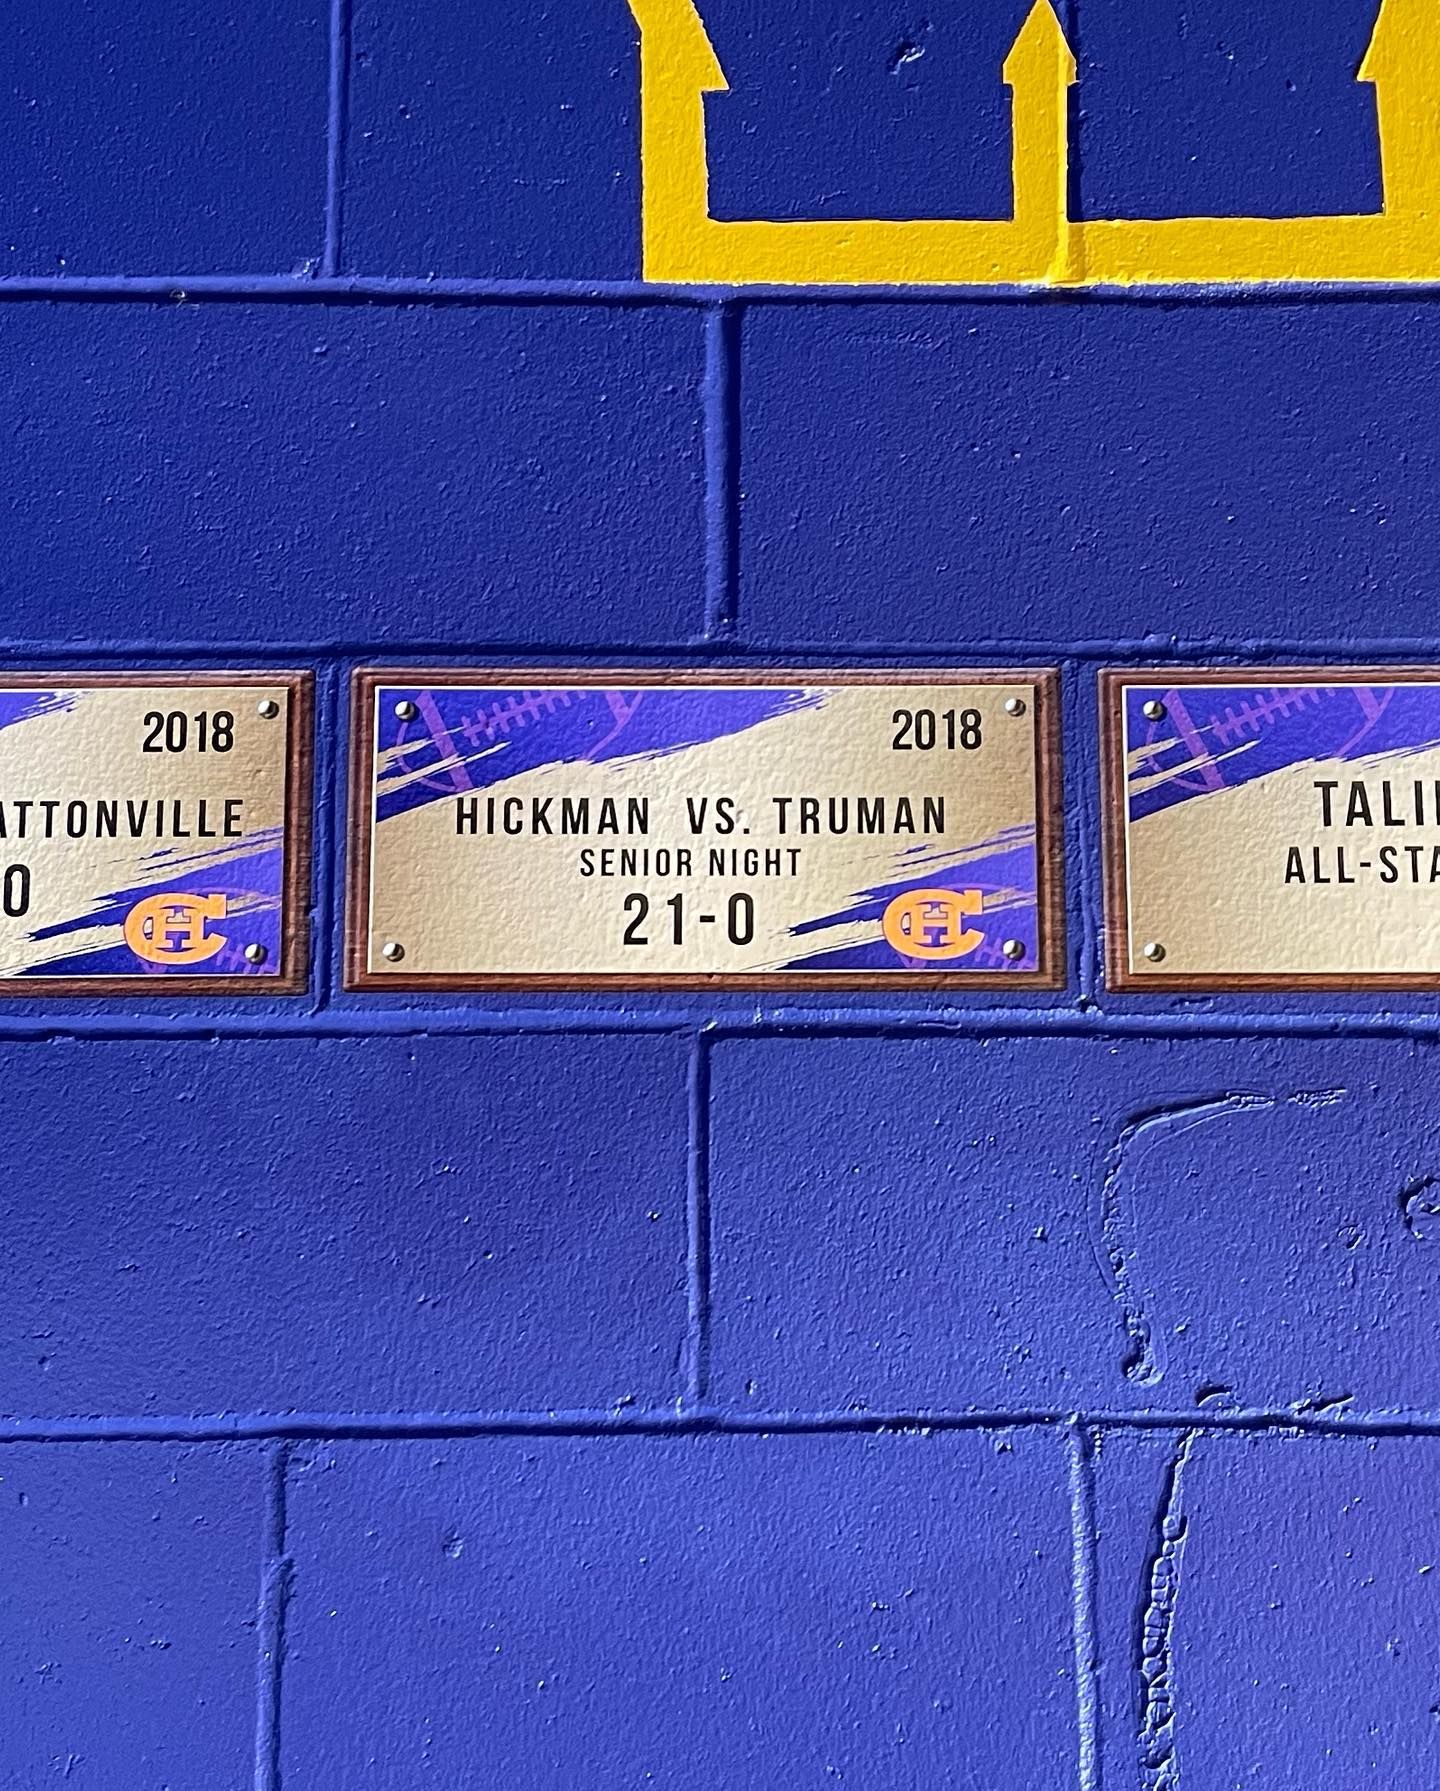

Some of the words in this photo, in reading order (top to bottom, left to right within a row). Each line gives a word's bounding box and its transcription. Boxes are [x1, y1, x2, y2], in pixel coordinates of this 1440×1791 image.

[142, 710, 235, 753] 2018
[892, 708, 982, 751] 2018
[456, 796, 649, 835] HICKMAN
[686, 797, 750, 835] VS.
[773, 796, 945, 835] TRUMAN
[1313, 780, 1440, 827] TALI
[580, 848, 692, 877] SENIOR
[709, 848, 802, 877] NIGHT
[623, 892, 754, 946] 21-0
